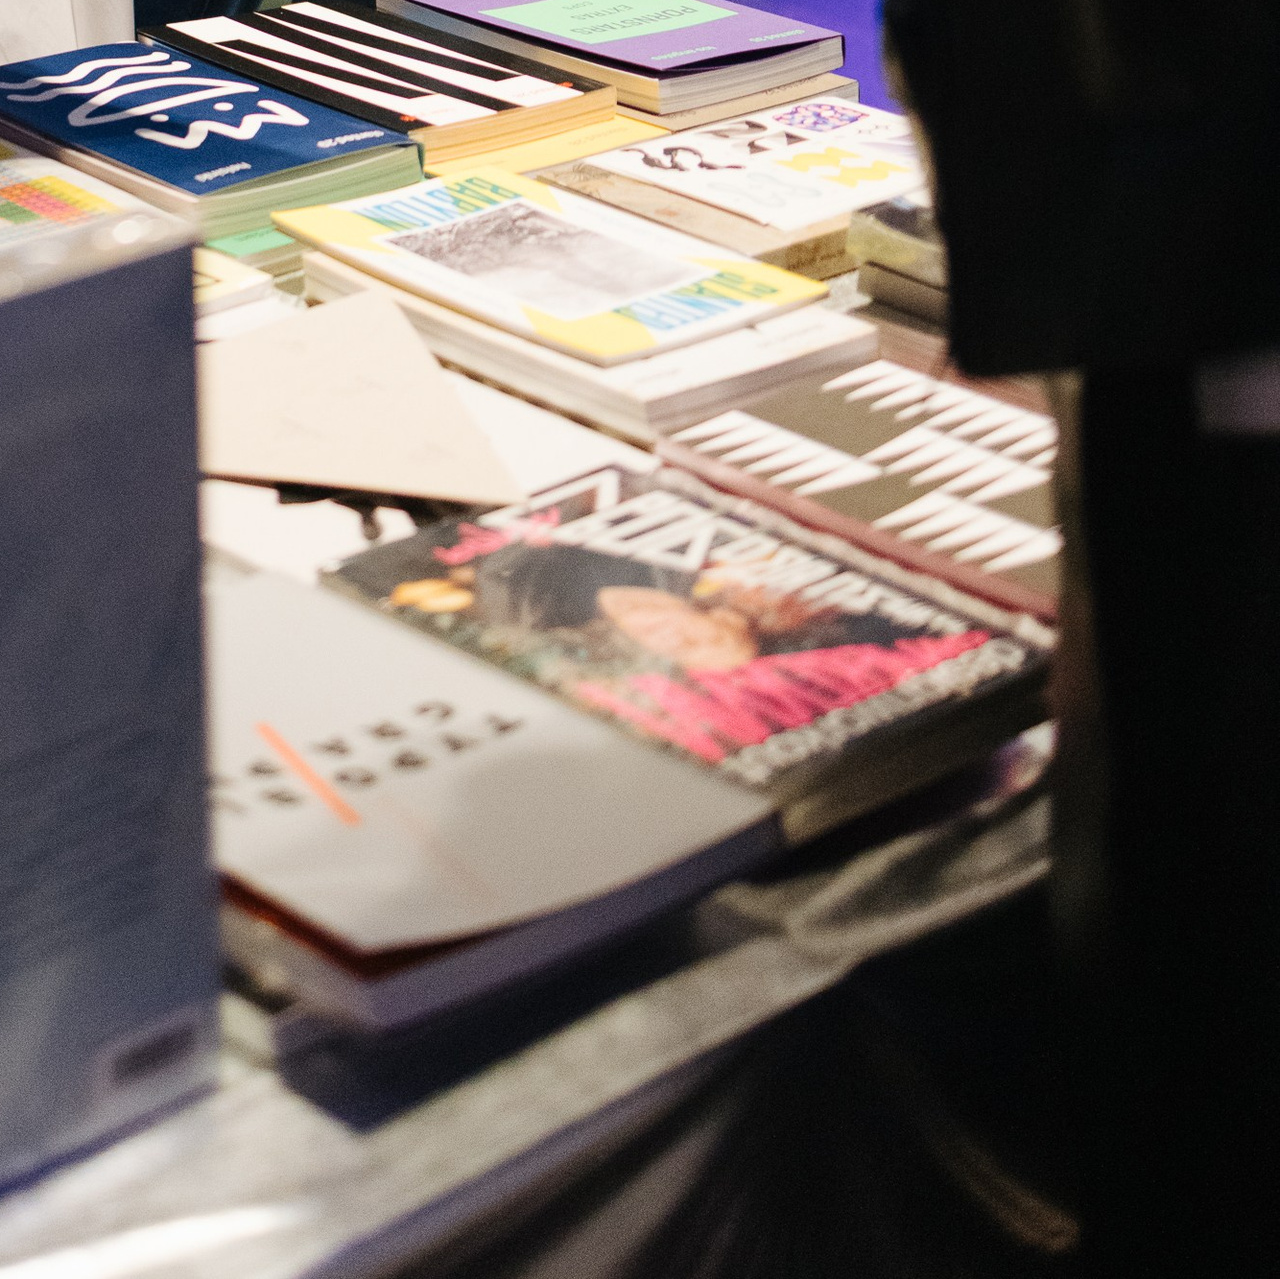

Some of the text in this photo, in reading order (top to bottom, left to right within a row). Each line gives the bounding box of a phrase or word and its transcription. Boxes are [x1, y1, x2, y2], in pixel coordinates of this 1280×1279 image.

[570, 4, 633, 21] EXTRAS
[570, 5, 698, 36] PORNSTARS
[355, 176, 521, 232] BABYLON
